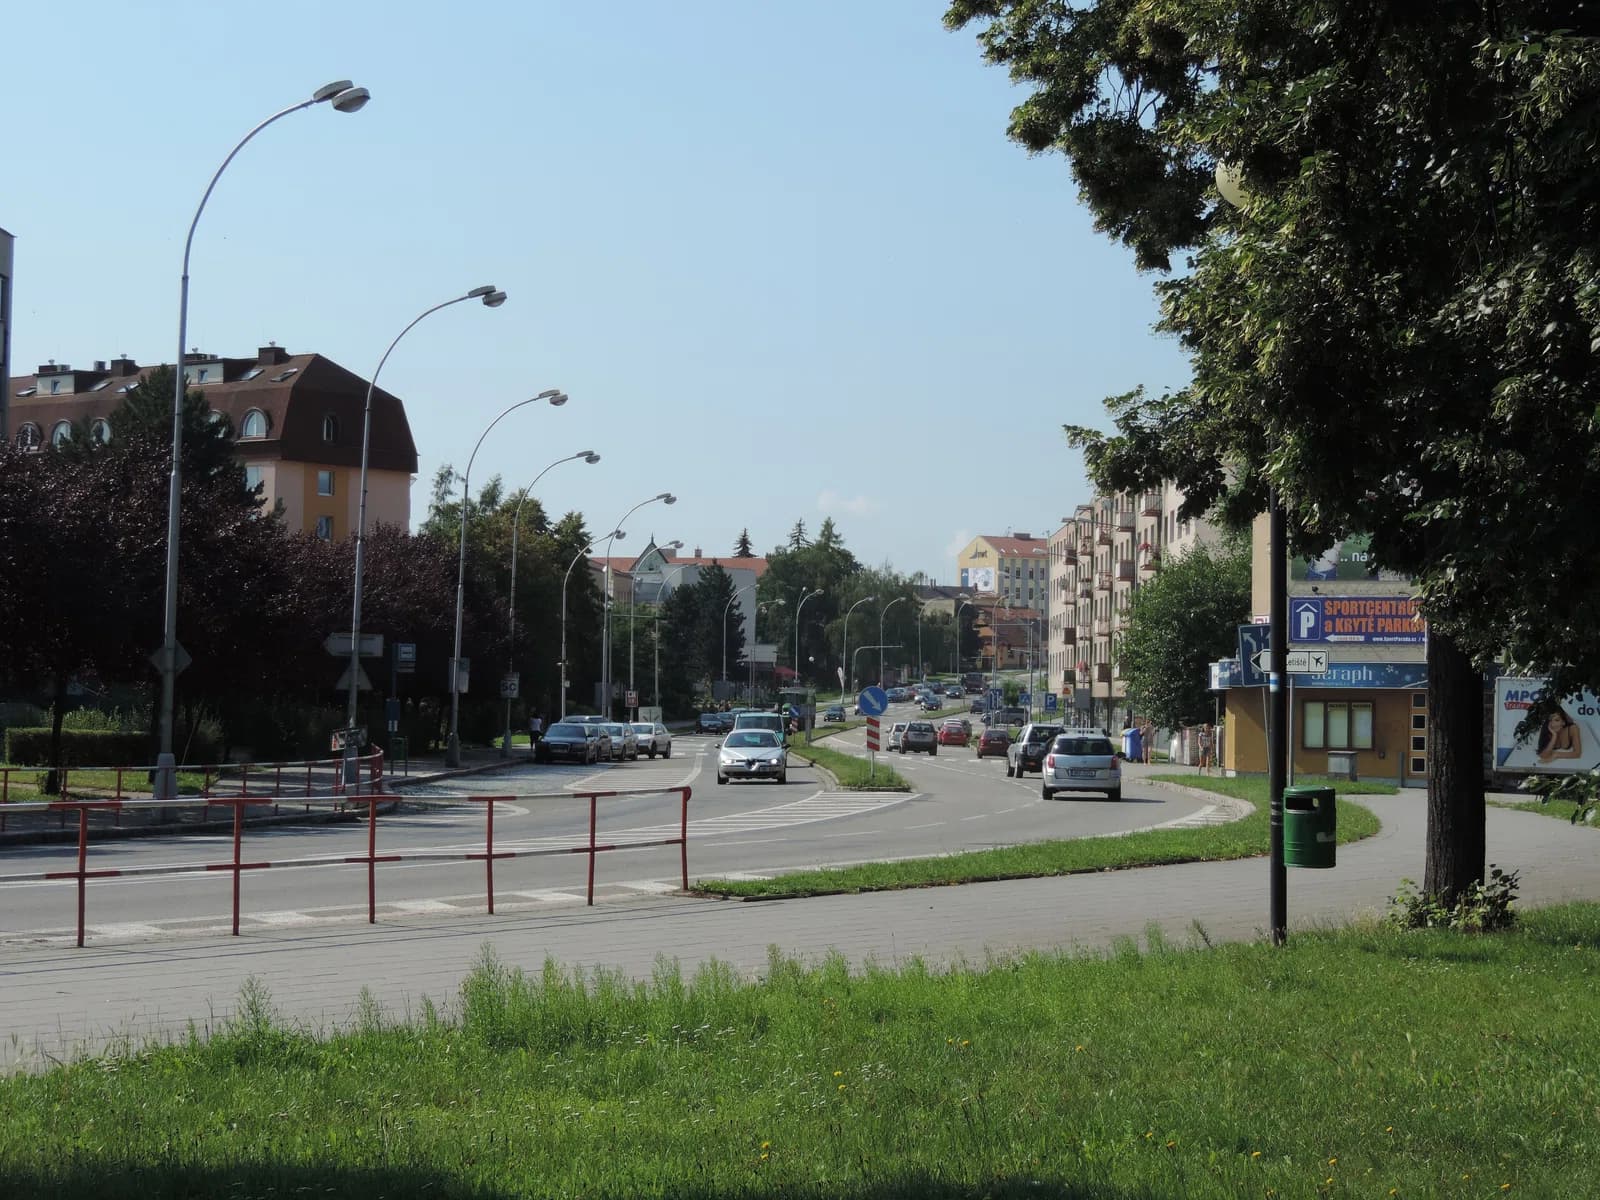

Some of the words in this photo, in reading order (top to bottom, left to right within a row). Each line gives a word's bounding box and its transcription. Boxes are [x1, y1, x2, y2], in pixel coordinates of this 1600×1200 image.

[1324, 619, 1333, 633] a
[1335, 615, 1375, 633] KRYTÉ
[1286, 657, 1307, 667] etiště
